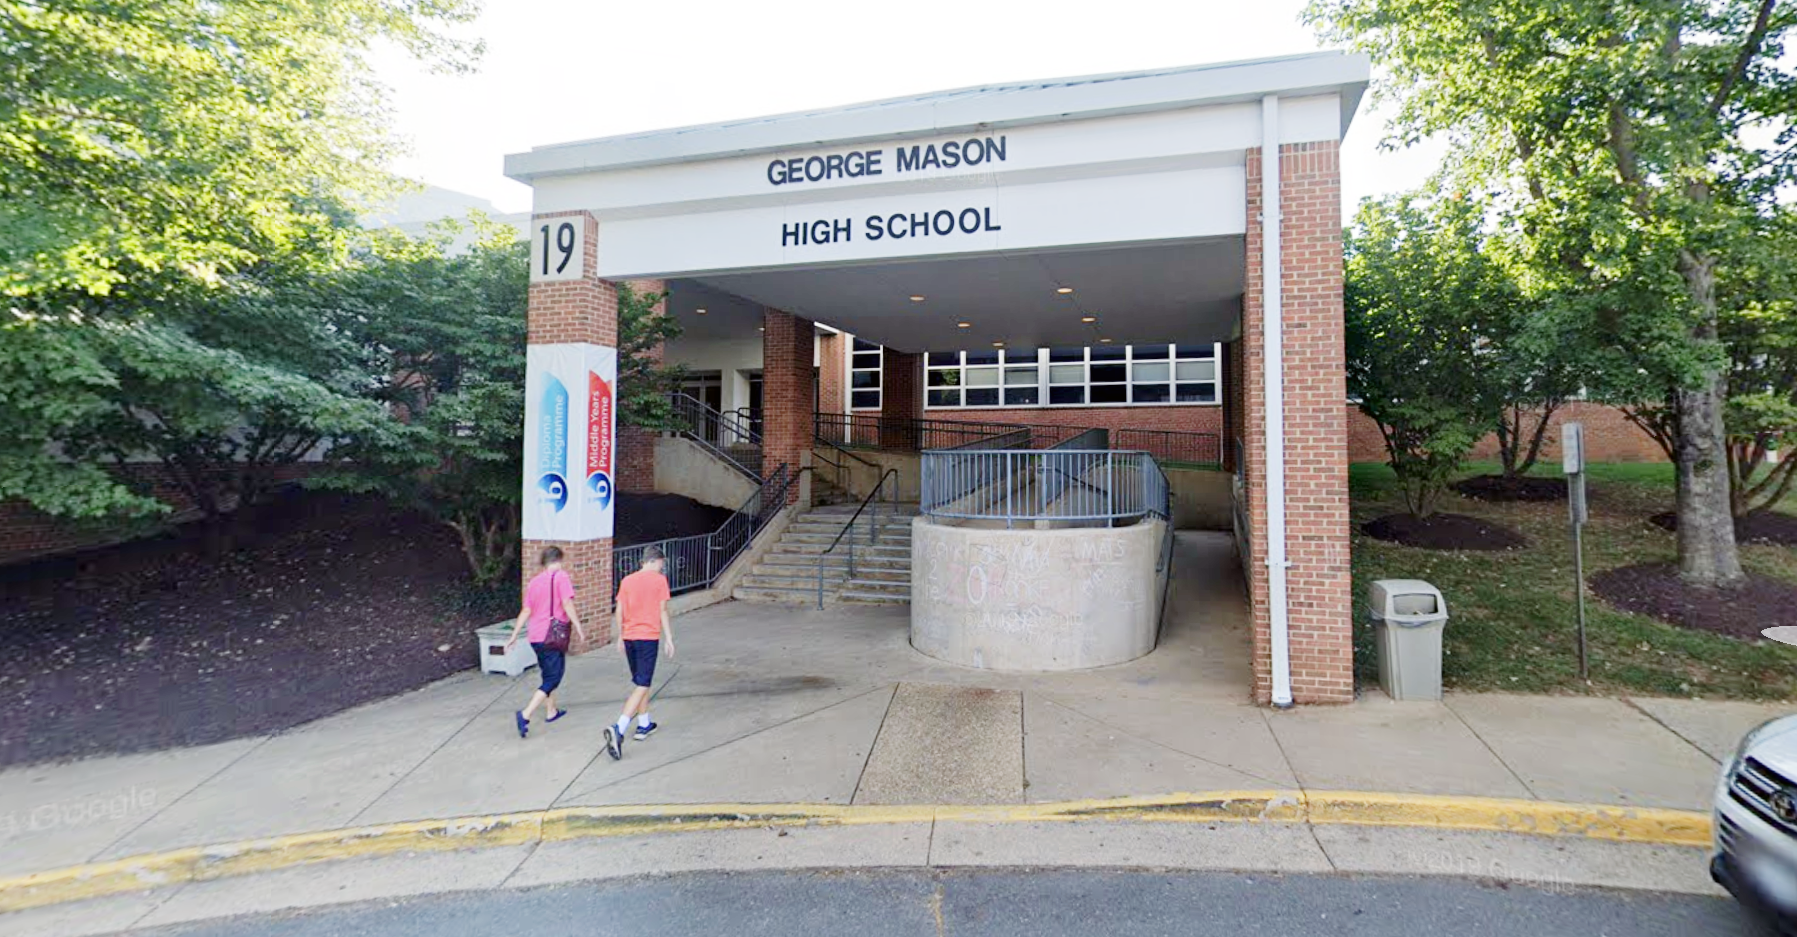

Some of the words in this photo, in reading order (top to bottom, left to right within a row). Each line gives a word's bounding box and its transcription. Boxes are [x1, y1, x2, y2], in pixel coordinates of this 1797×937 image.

[767, 149, 883, 186] GEORGE
[896, 136, 1006, 173] MASON
[540, 222, 575, 276] 19
[782, 217, 851, 247] HIGH
[865, 206, 1002, 241] SCHOOL
[552, 394, 565, 468] Programme
[590, 391, 600, 422] Years
[599, 396, 610, 467] Programme
[541, 415, 552, 468] Diploma
[589, 424, 599, 467] Middle
